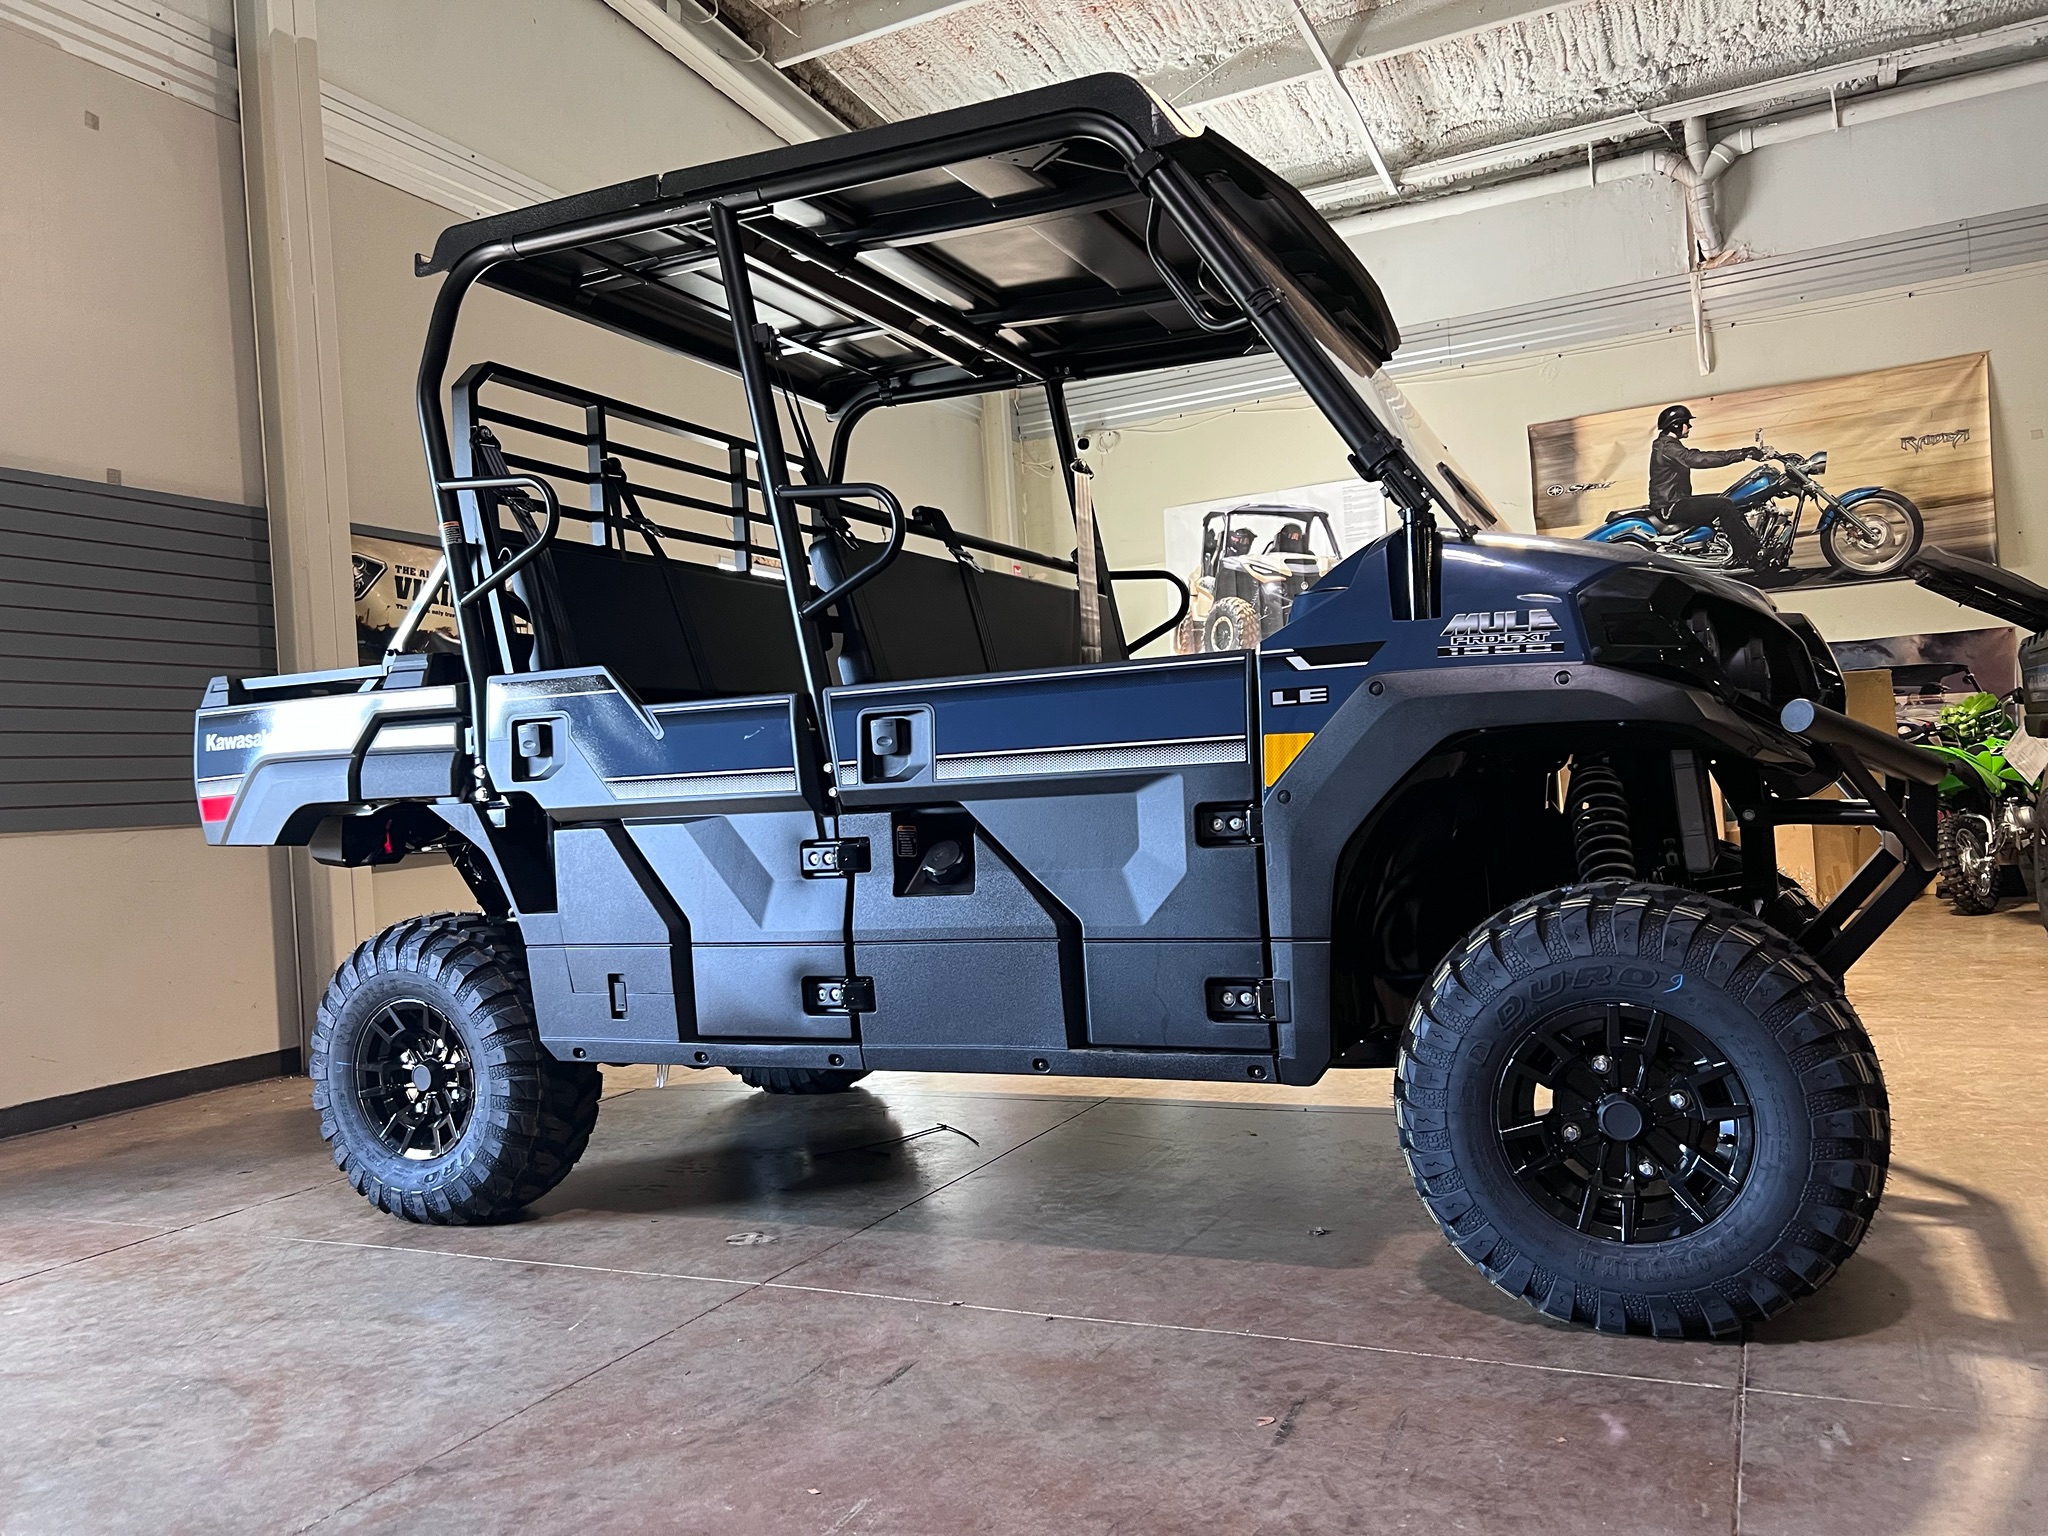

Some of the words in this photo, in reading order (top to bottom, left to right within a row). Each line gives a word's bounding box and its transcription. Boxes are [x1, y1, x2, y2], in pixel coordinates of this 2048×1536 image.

[394, 564, 416, 577] THE
[1440, 608, 1562, 637] MULE
[1450, 631, 1551, 646] PRO-FXT
[1448, 643, 1553, 656] 1000
[1272, 687, 1328, 706] LE
[1495, 964, 1660, 1030] DURO
